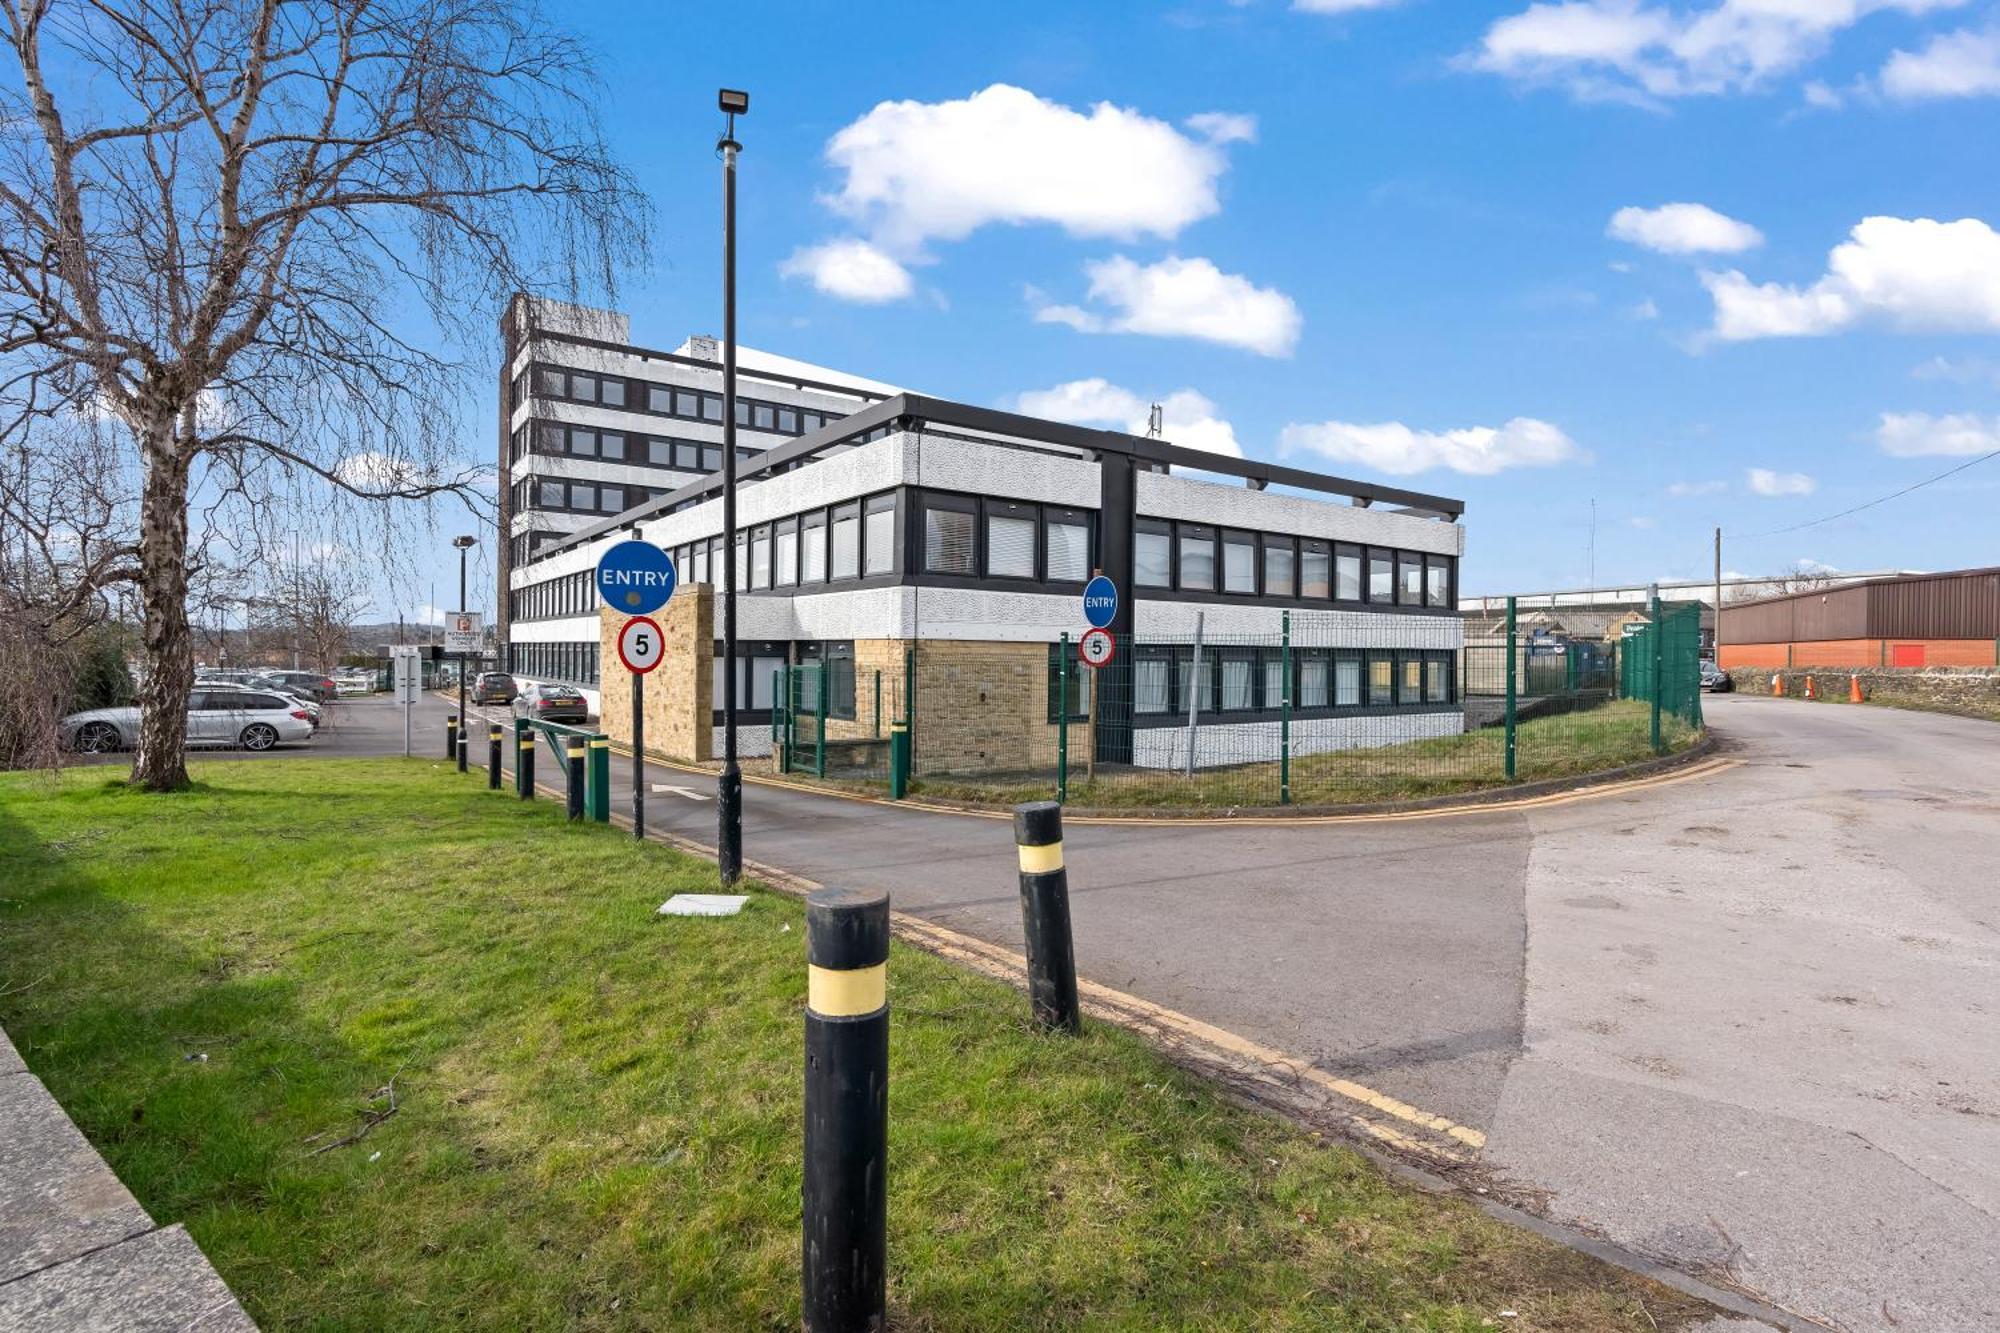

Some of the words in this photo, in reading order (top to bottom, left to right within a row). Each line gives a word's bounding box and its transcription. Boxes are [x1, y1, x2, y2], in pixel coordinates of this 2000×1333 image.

[602, 569, 670, 586] ENTRY
[1086, 597, 1114, 608] ENTRY
[635, 634, 649, 656] 5
[1092, 640, 1102, 655] 5
